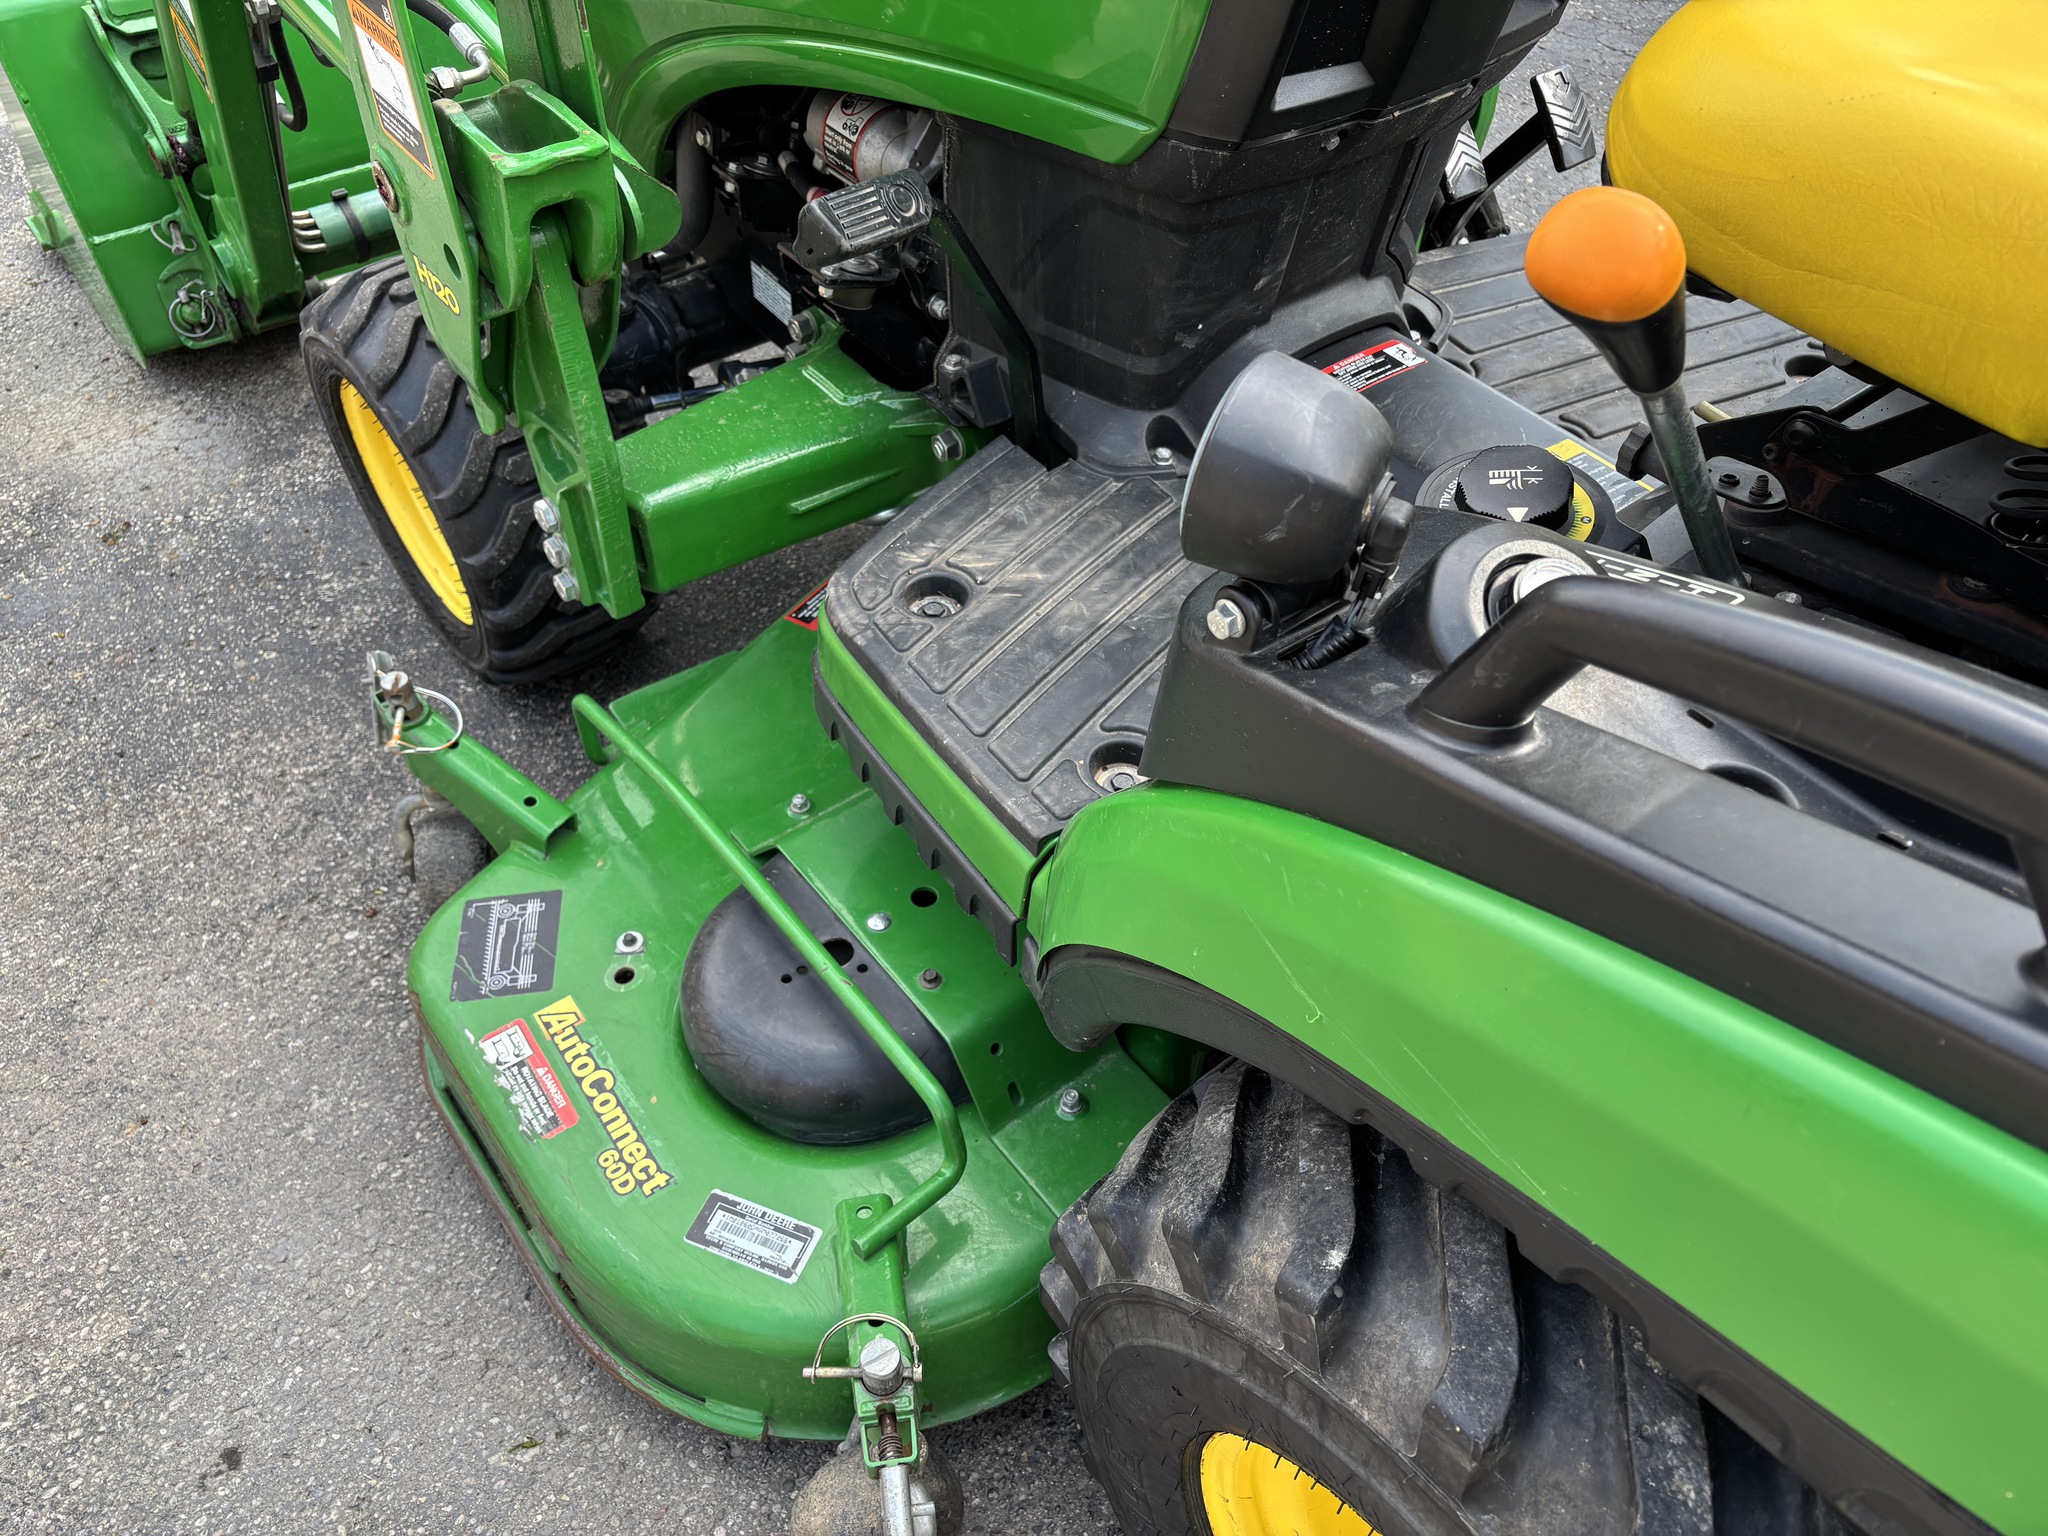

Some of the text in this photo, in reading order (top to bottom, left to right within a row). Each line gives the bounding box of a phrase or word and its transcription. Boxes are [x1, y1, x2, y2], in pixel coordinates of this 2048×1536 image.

[357, 8, 400, 57] WARNING
[412, 254, 460, 315] H120
[1339, 353, 1366, 367] DANGER
[1438, 477, 1458, 508] NSTALL
[520, 1066, 542, 1100] ROTATING
[542, 1073, 567, 1108] DANGER
[540, 1013, 671, 1196] AutoConnect
[598, 1149, 636, 1195] 60D
[737, 1202, 796, 1230] JOHN DEERE
